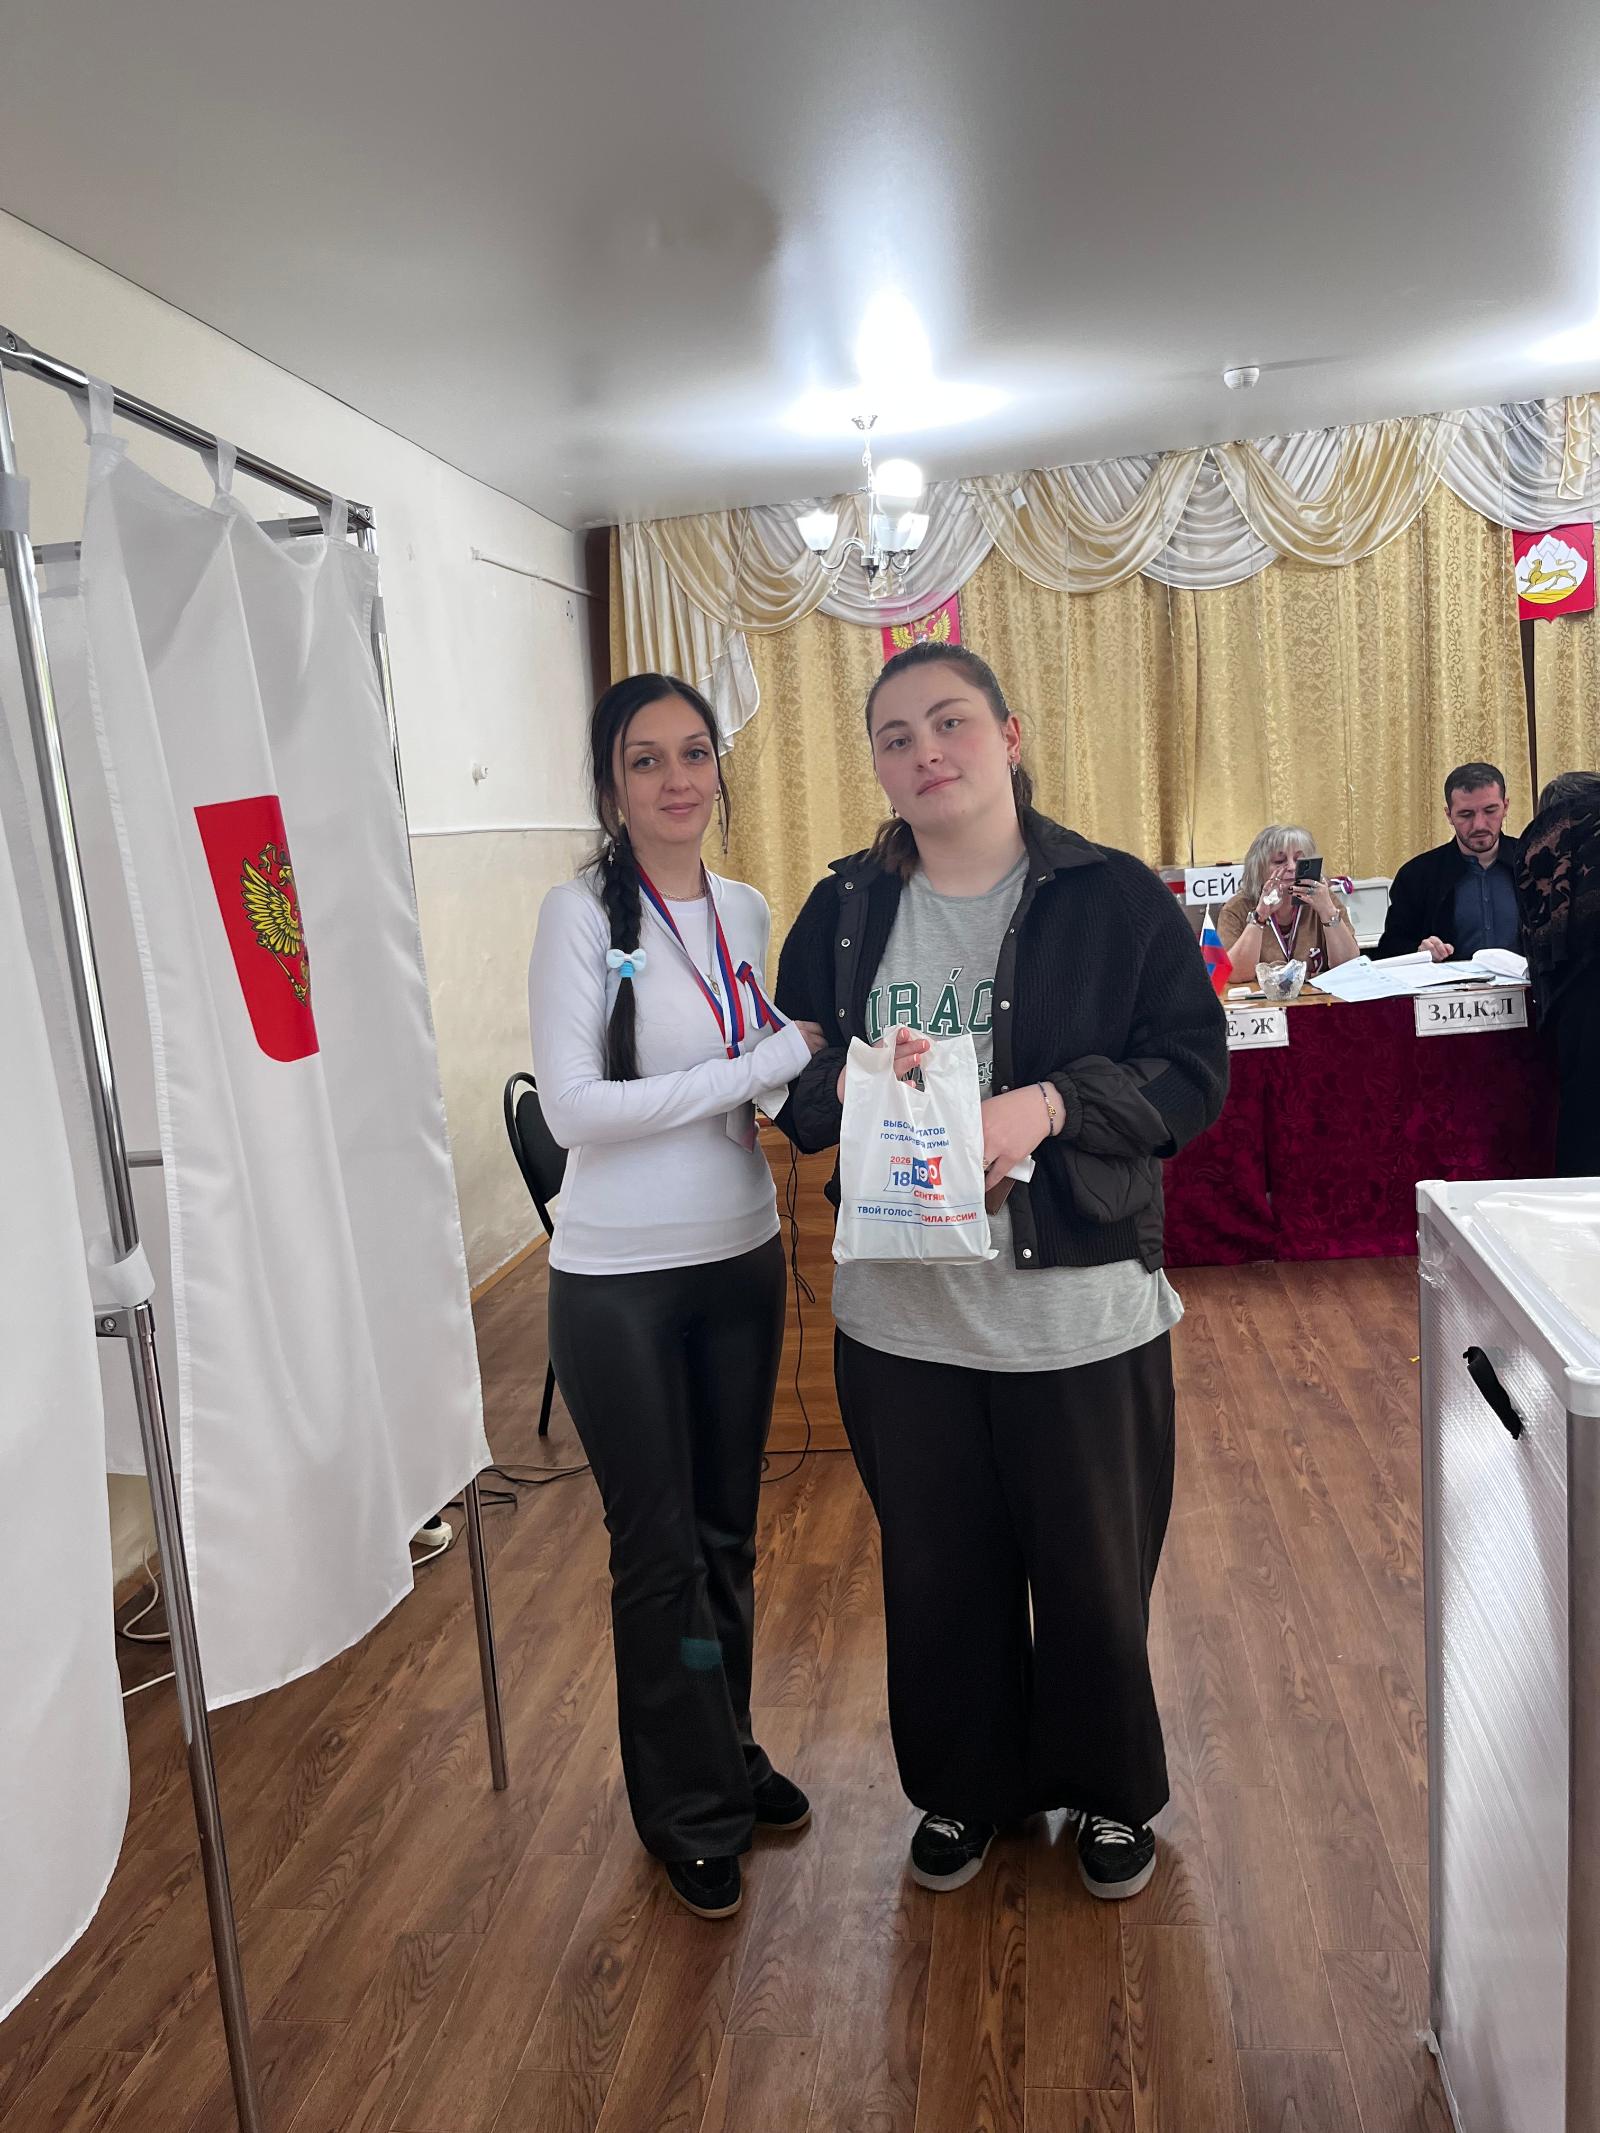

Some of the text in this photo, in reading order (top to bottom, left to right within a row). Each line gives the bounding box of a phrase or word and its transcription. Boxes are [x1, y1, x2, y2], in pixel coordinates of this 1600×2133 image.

[1192, 872, 1243, 898] СЕЙ
[890, 1156, 911, 1164] 2026
[892, 1171, 911, 1187] 18
[914, 1165, 929, 1182] 19
[857, 1206, 881, 1215] ТВОЙ
[883, 1208, 913, 1217] ГОЛОС
